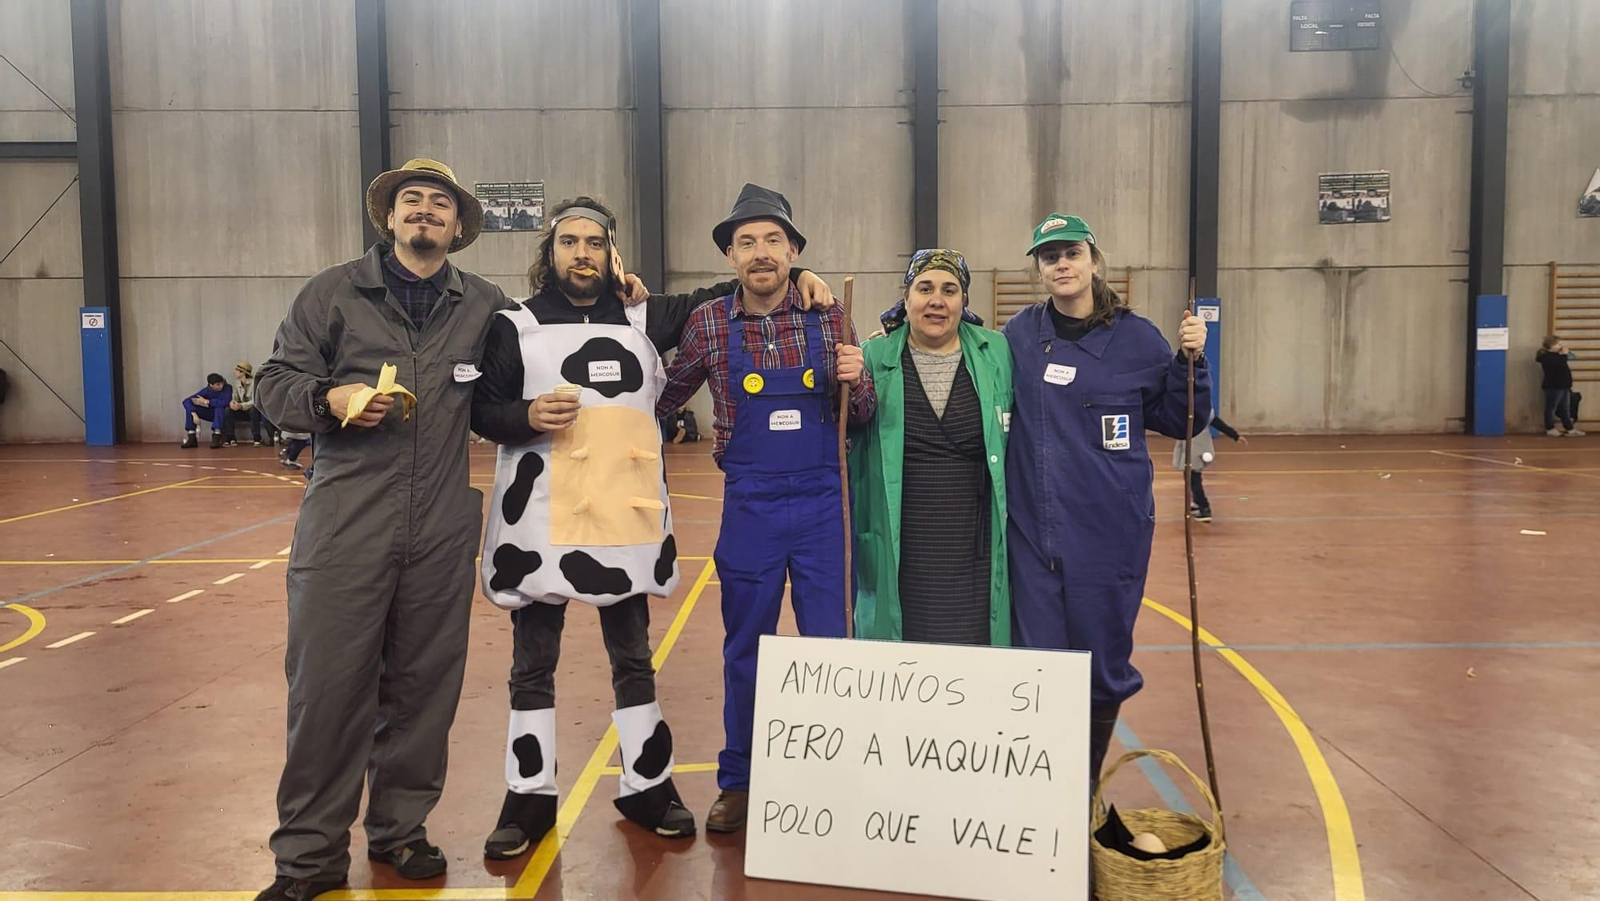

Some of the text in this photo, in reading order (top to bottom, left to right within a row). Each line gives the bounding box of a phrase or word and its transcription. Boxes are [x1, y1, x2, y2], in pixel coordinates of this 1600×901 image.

[780, 660, 966, 706] AMIGUIÑOS
[766, 718, 1053, 782] PERO A VAQUIÑA
[763, 800, 834, 838] POLO
[865, 810, 920, 844] QUE
